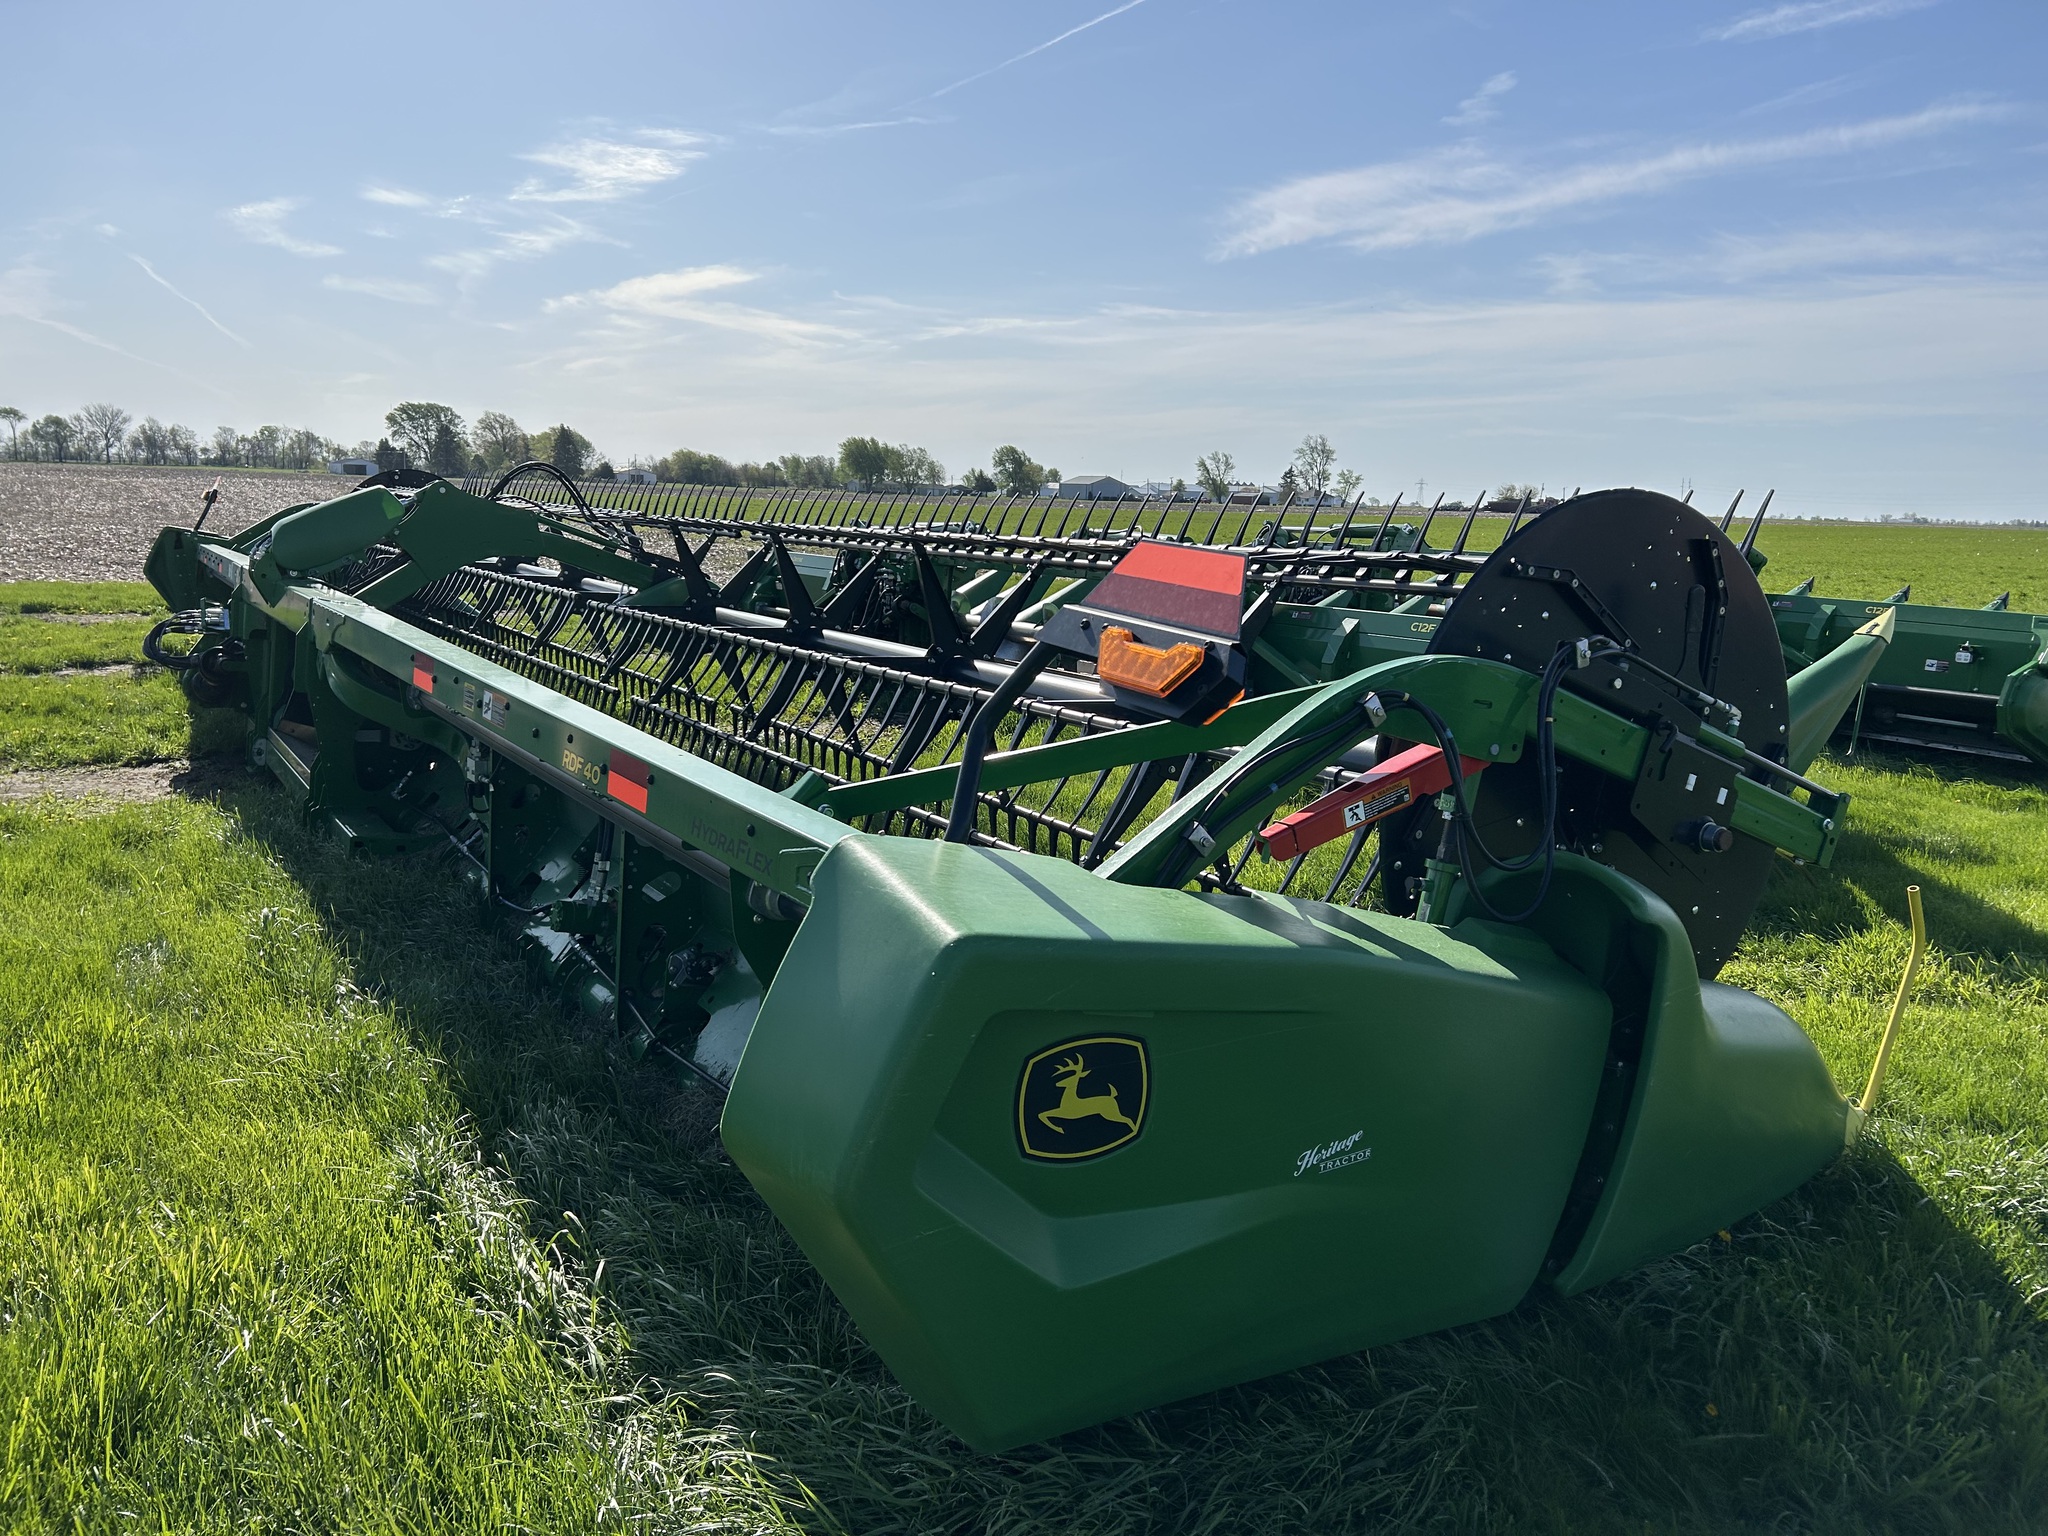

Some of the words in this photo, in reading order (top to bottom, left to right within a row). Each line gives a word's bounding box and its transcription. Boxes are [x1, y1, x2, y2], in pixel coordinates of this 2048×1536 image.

[1410, 622, 1437, 633] C12F
[562, 749, 584, 774] RDF
[583, 762, 601, 785] 40
[1377, 782, 1403, 797] WARNING
[1294, 1130, 1363, 1176] Heritage
[1320, 1149, 1371, 1172] TRACTOR
